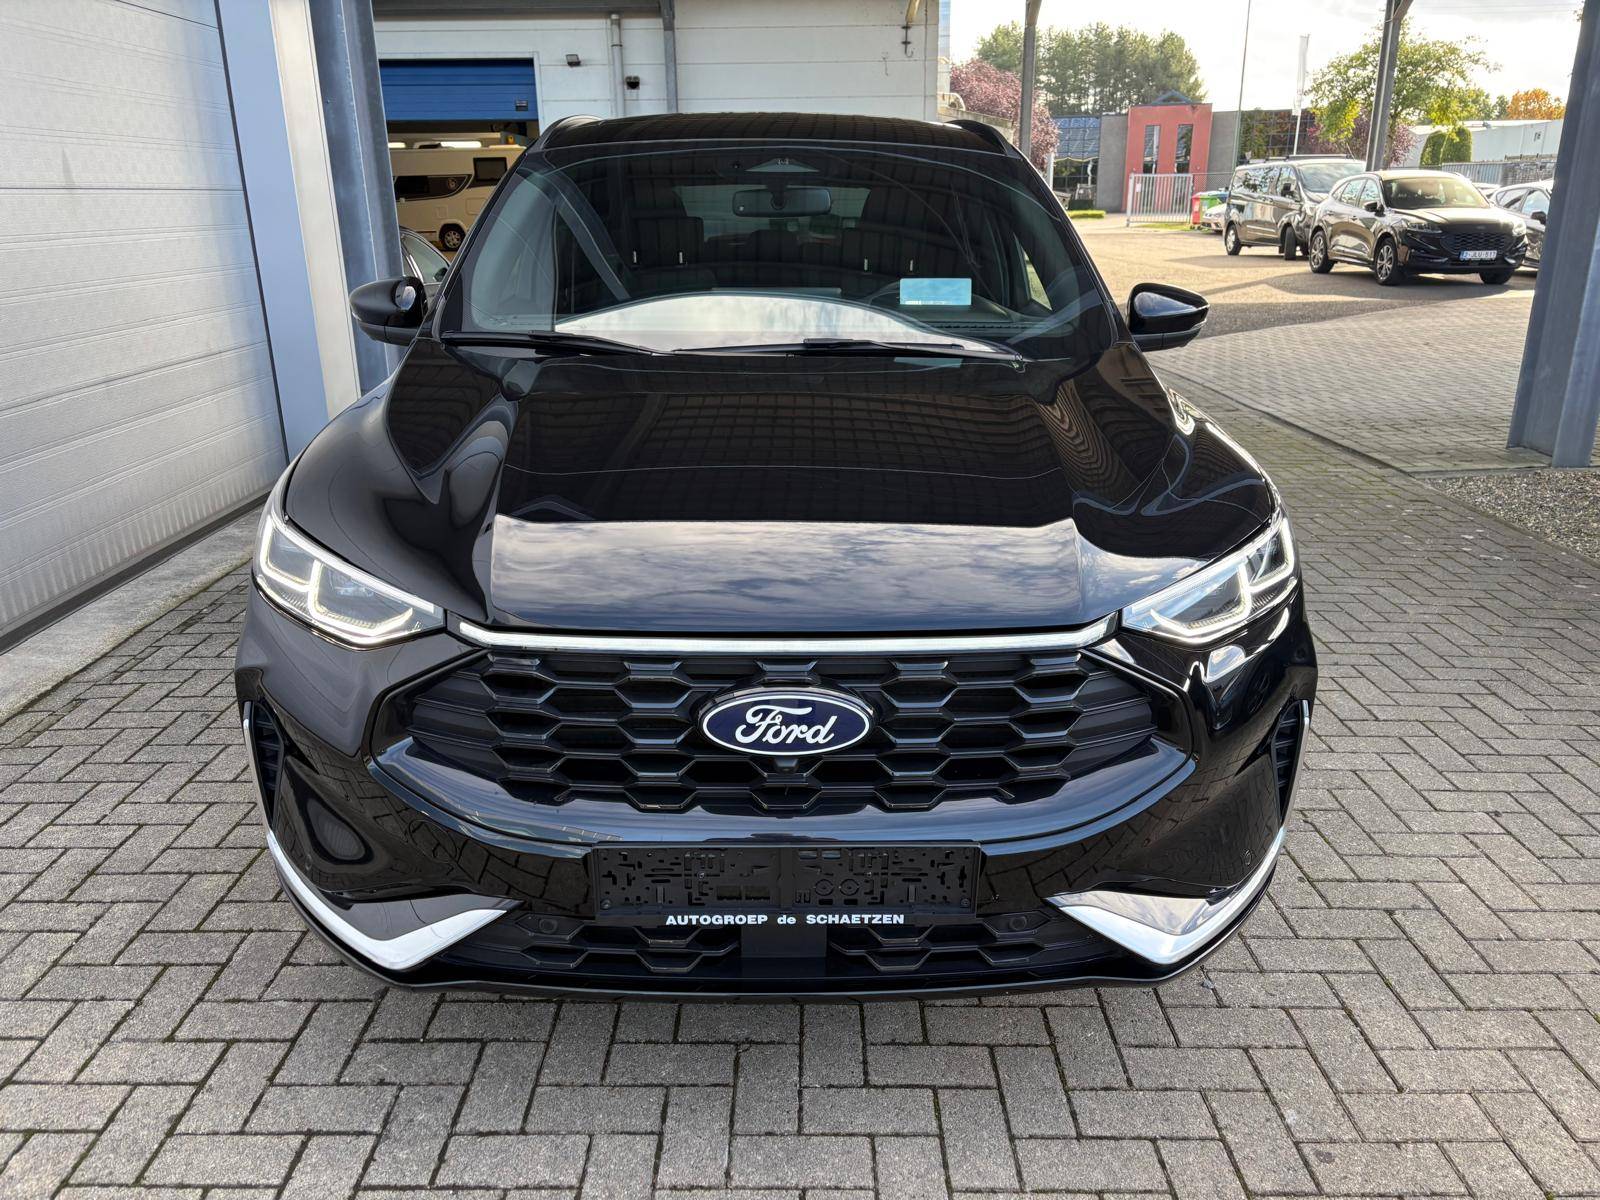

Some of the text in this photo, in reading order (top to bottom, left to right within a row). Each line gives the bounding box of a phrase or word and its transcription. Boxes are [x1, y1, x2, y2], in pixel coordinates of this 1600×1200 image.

[735, 705, 838, 744] Ford
[665, 914, 905, 926] AUTOGROEP de SCHAETZEN
